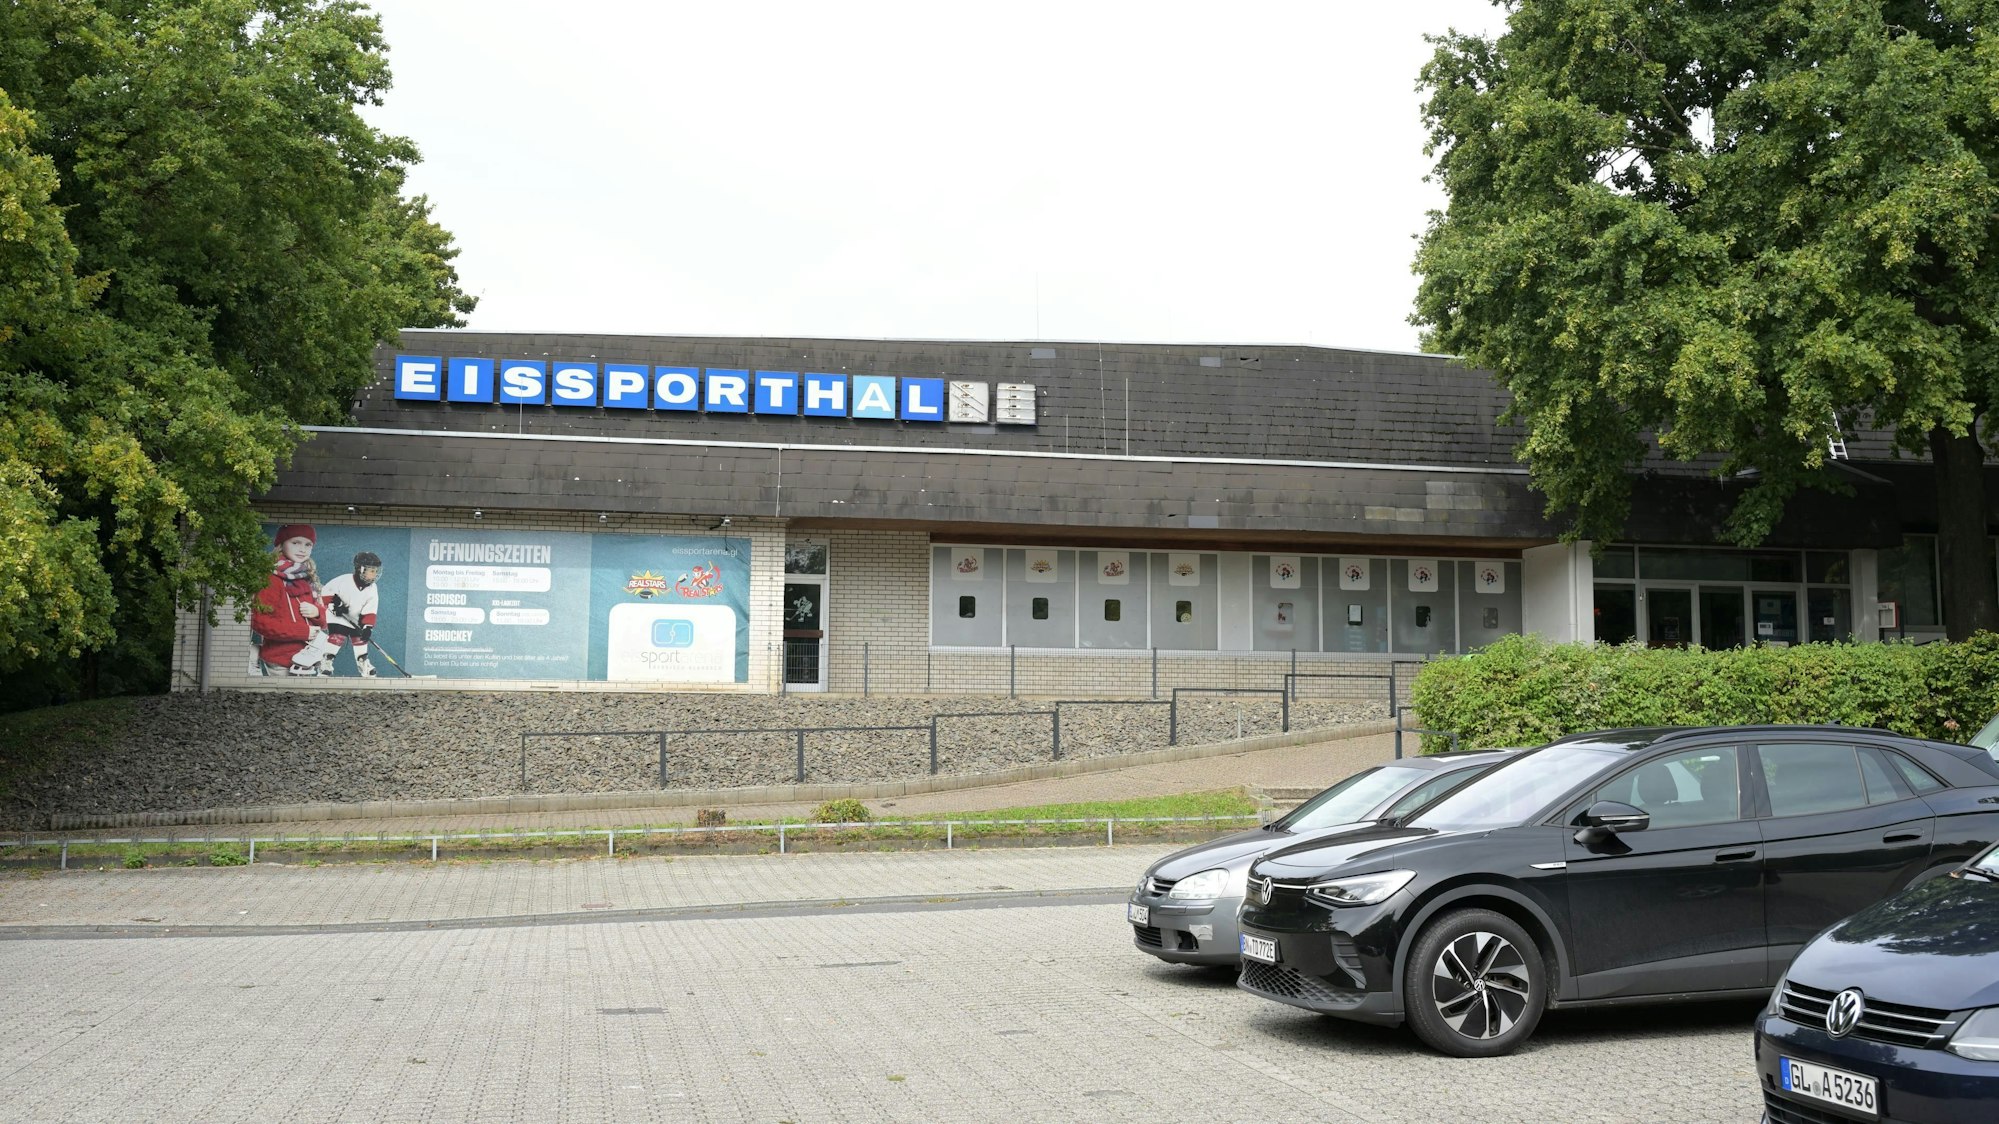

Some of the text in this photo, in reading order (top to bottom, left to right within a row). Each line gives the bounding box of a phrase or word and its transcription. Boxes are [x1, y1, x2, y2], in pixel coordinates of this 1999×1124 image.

[429, 539, 551, 564] ÖFFNUNGSZEITEN
[672, 547, 738, 557] eissportarena.gl
[628, 579, 666, 588] REALSTARS
[427, 593, 467, 605] EISDISCO
[425, 629, 473, 642] EISHOCKEY
[1790, 1063, 1811, 1092] GL
